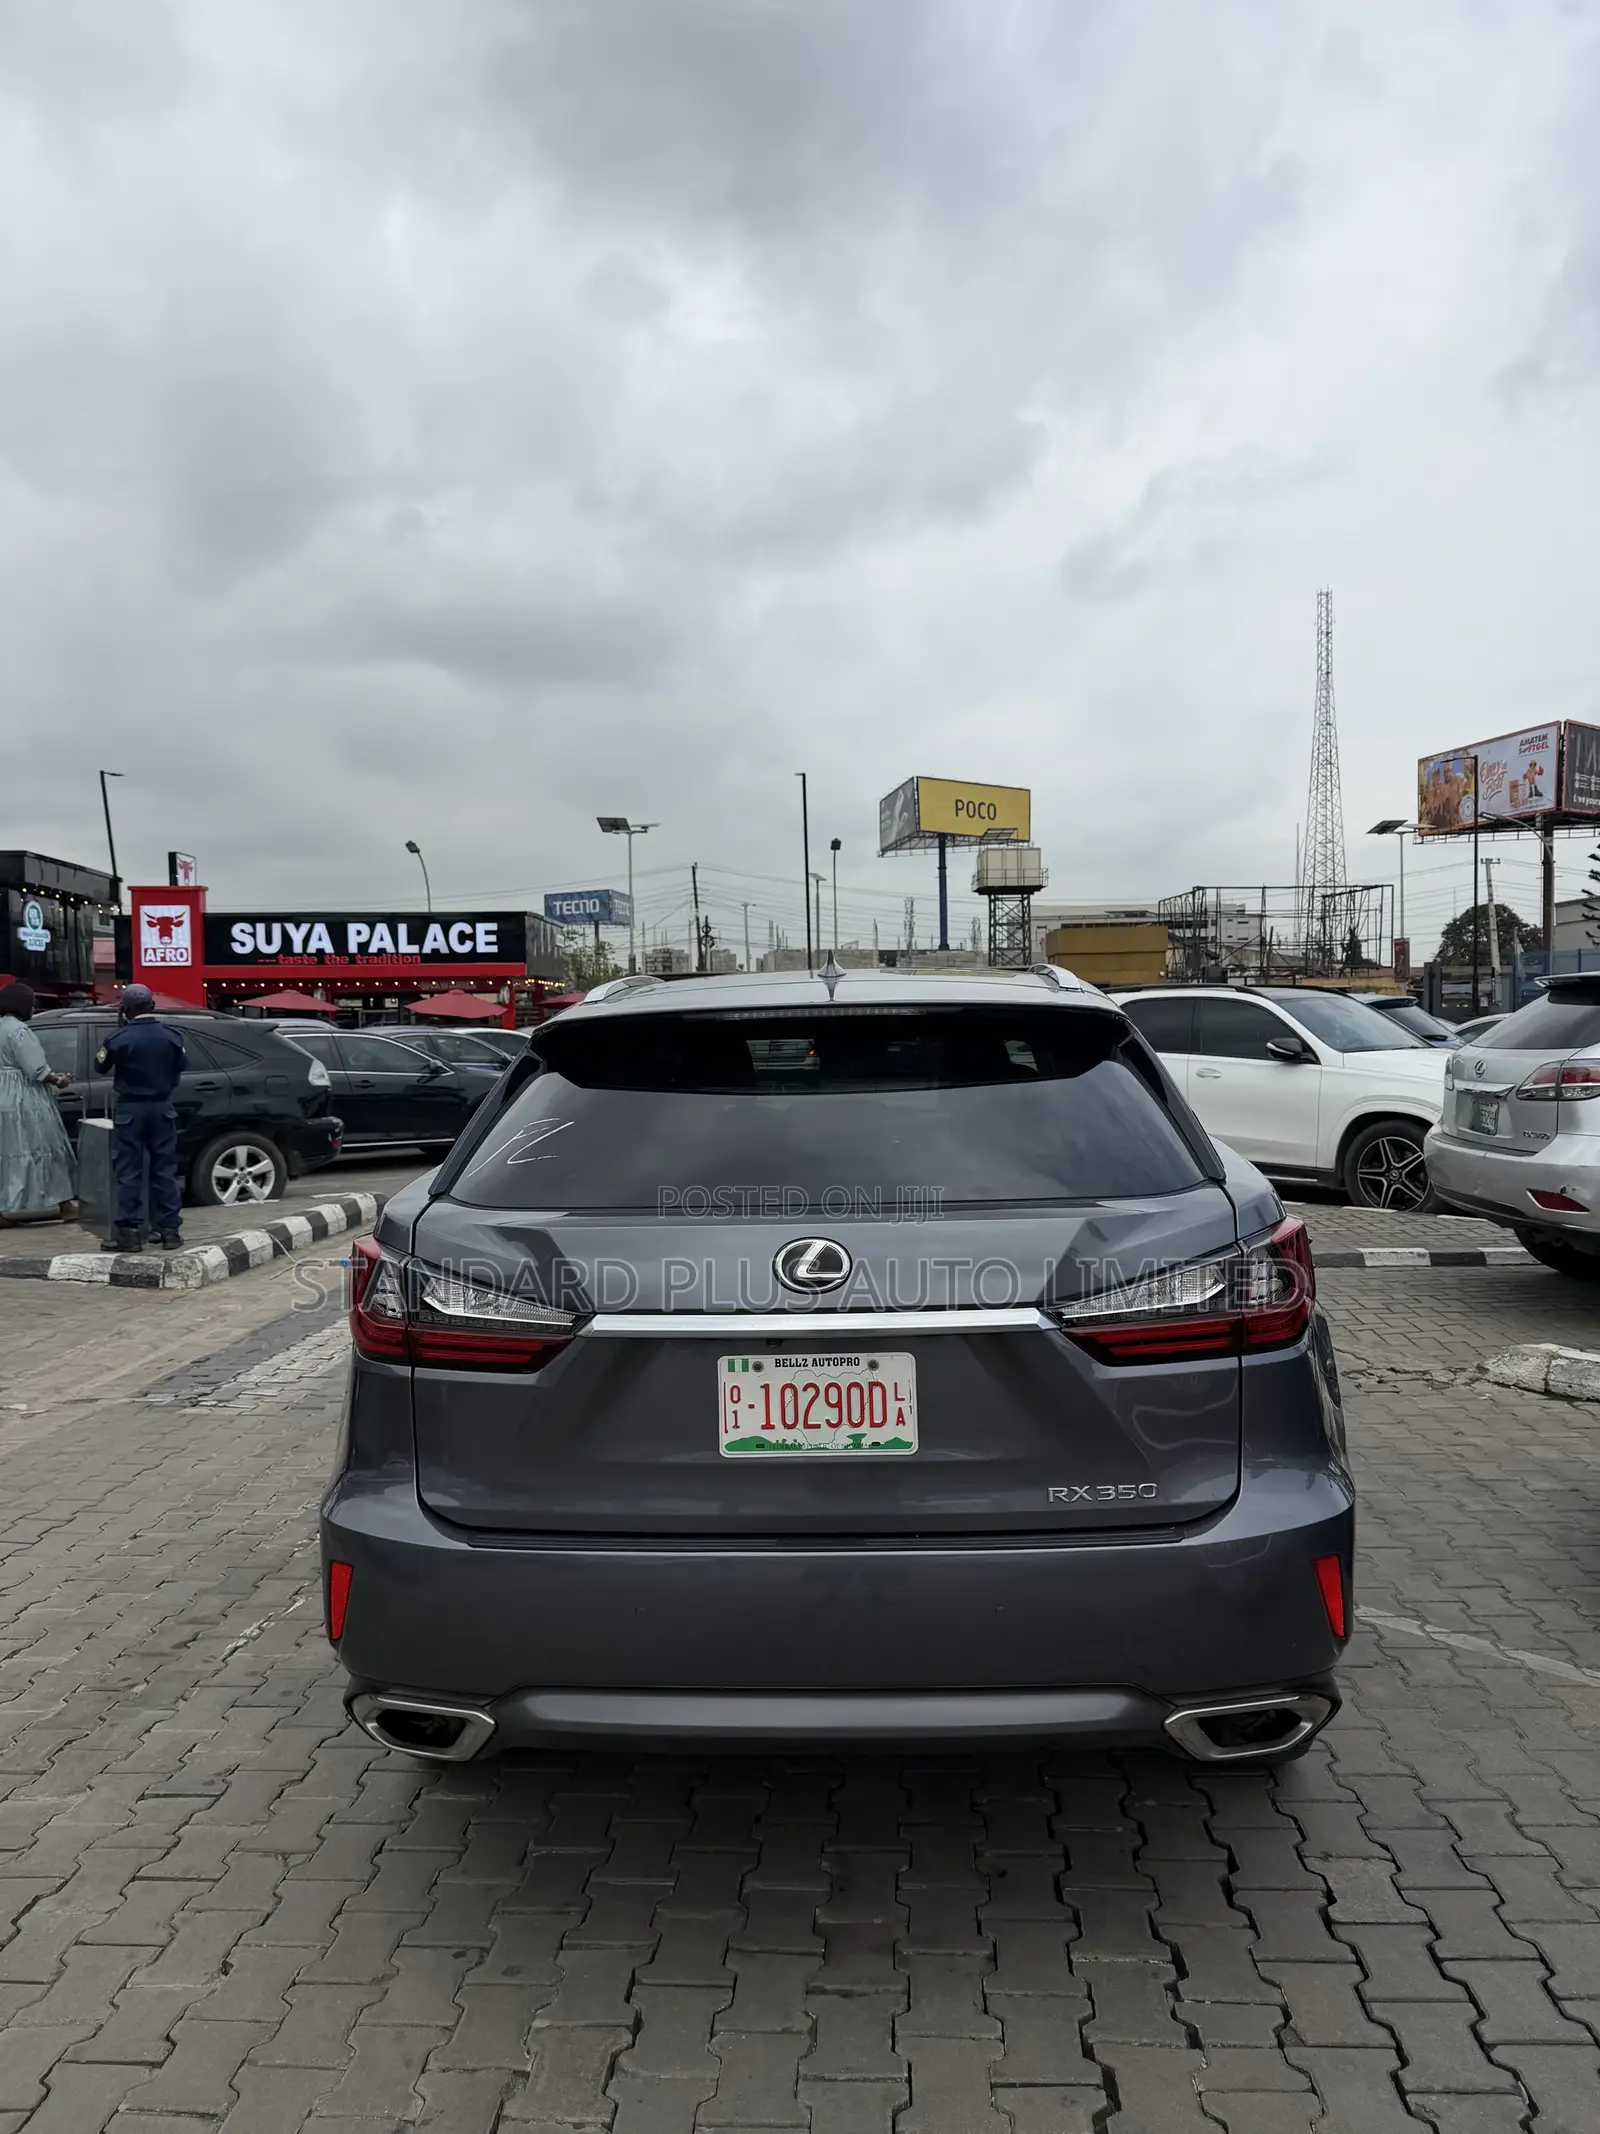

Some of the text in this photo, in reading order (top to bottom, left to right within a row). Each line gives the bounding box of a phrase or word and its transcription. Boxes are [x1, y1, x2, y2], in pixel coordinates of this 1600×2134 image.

[1519, 733, 1548, 748] AMATEM
[954, 798, 997, 821] POCO
[553, 898, 600, 915] TECNO
[230, 921, 499, 954] SUYA PALACE
[145, 948, 188, 962] AFRO
[278, 953, 421, 965] taste the tradition
[774, 1356, 861, 1368] BELLZ AUTOPRO
[1047, 1483, 1158, 1502] RX 350
